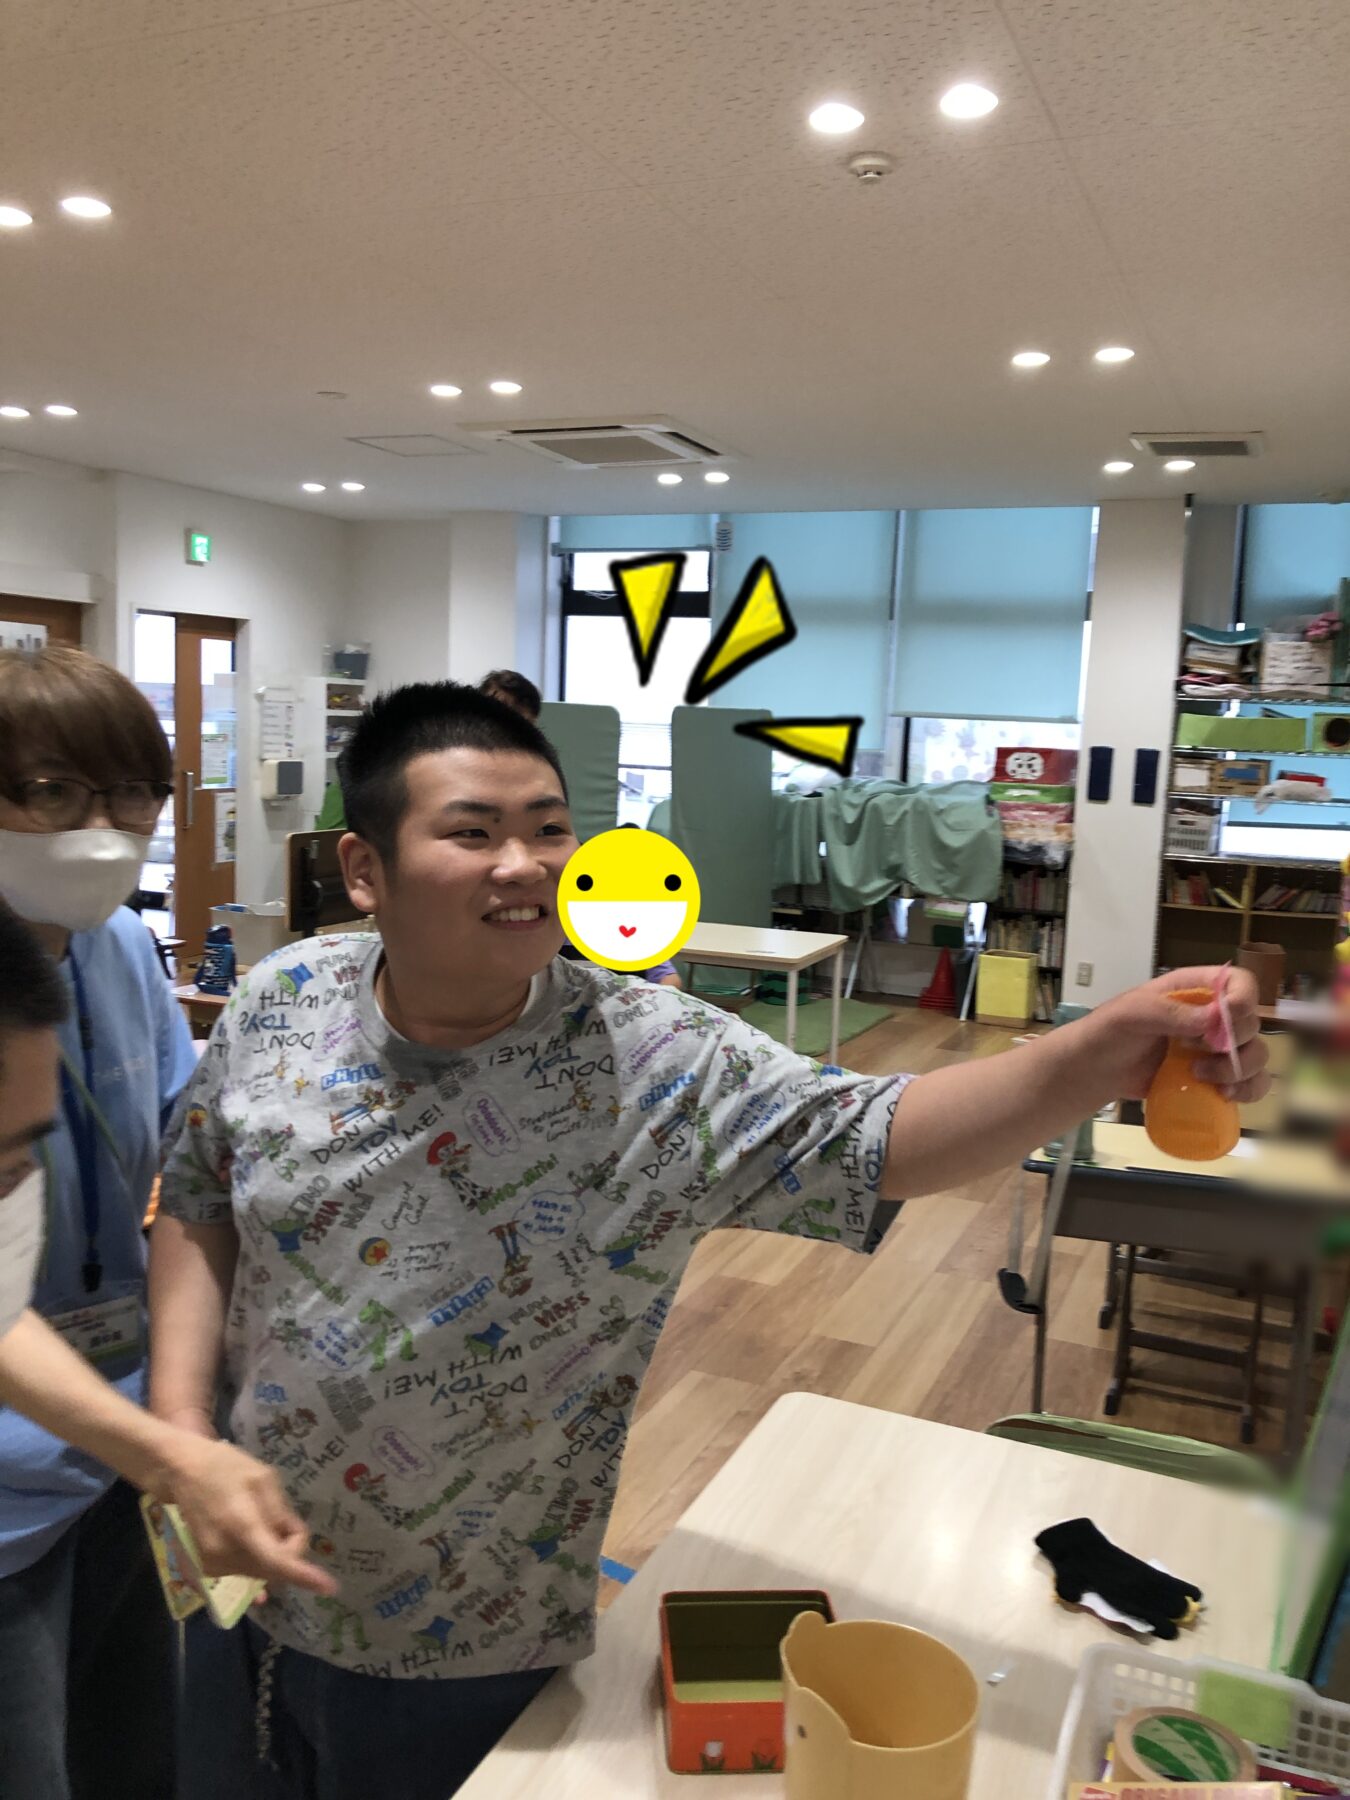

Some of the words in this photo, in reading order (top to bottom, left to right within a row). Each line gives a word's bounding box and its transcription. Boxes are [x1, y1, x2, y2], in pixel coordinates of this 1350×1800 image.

[320, 1062, 386, 1092] CHILL
[310, 1113, 377, 1165] DON'T
[342, 1141, 402, 1193] WITH
[401, 1103, 445, 1142] ME!
[350, 1115, 398, 1154] TOY
[534, 1291, 591, 1329] VIBES
[384, 1369, 437, 1400] ME!
